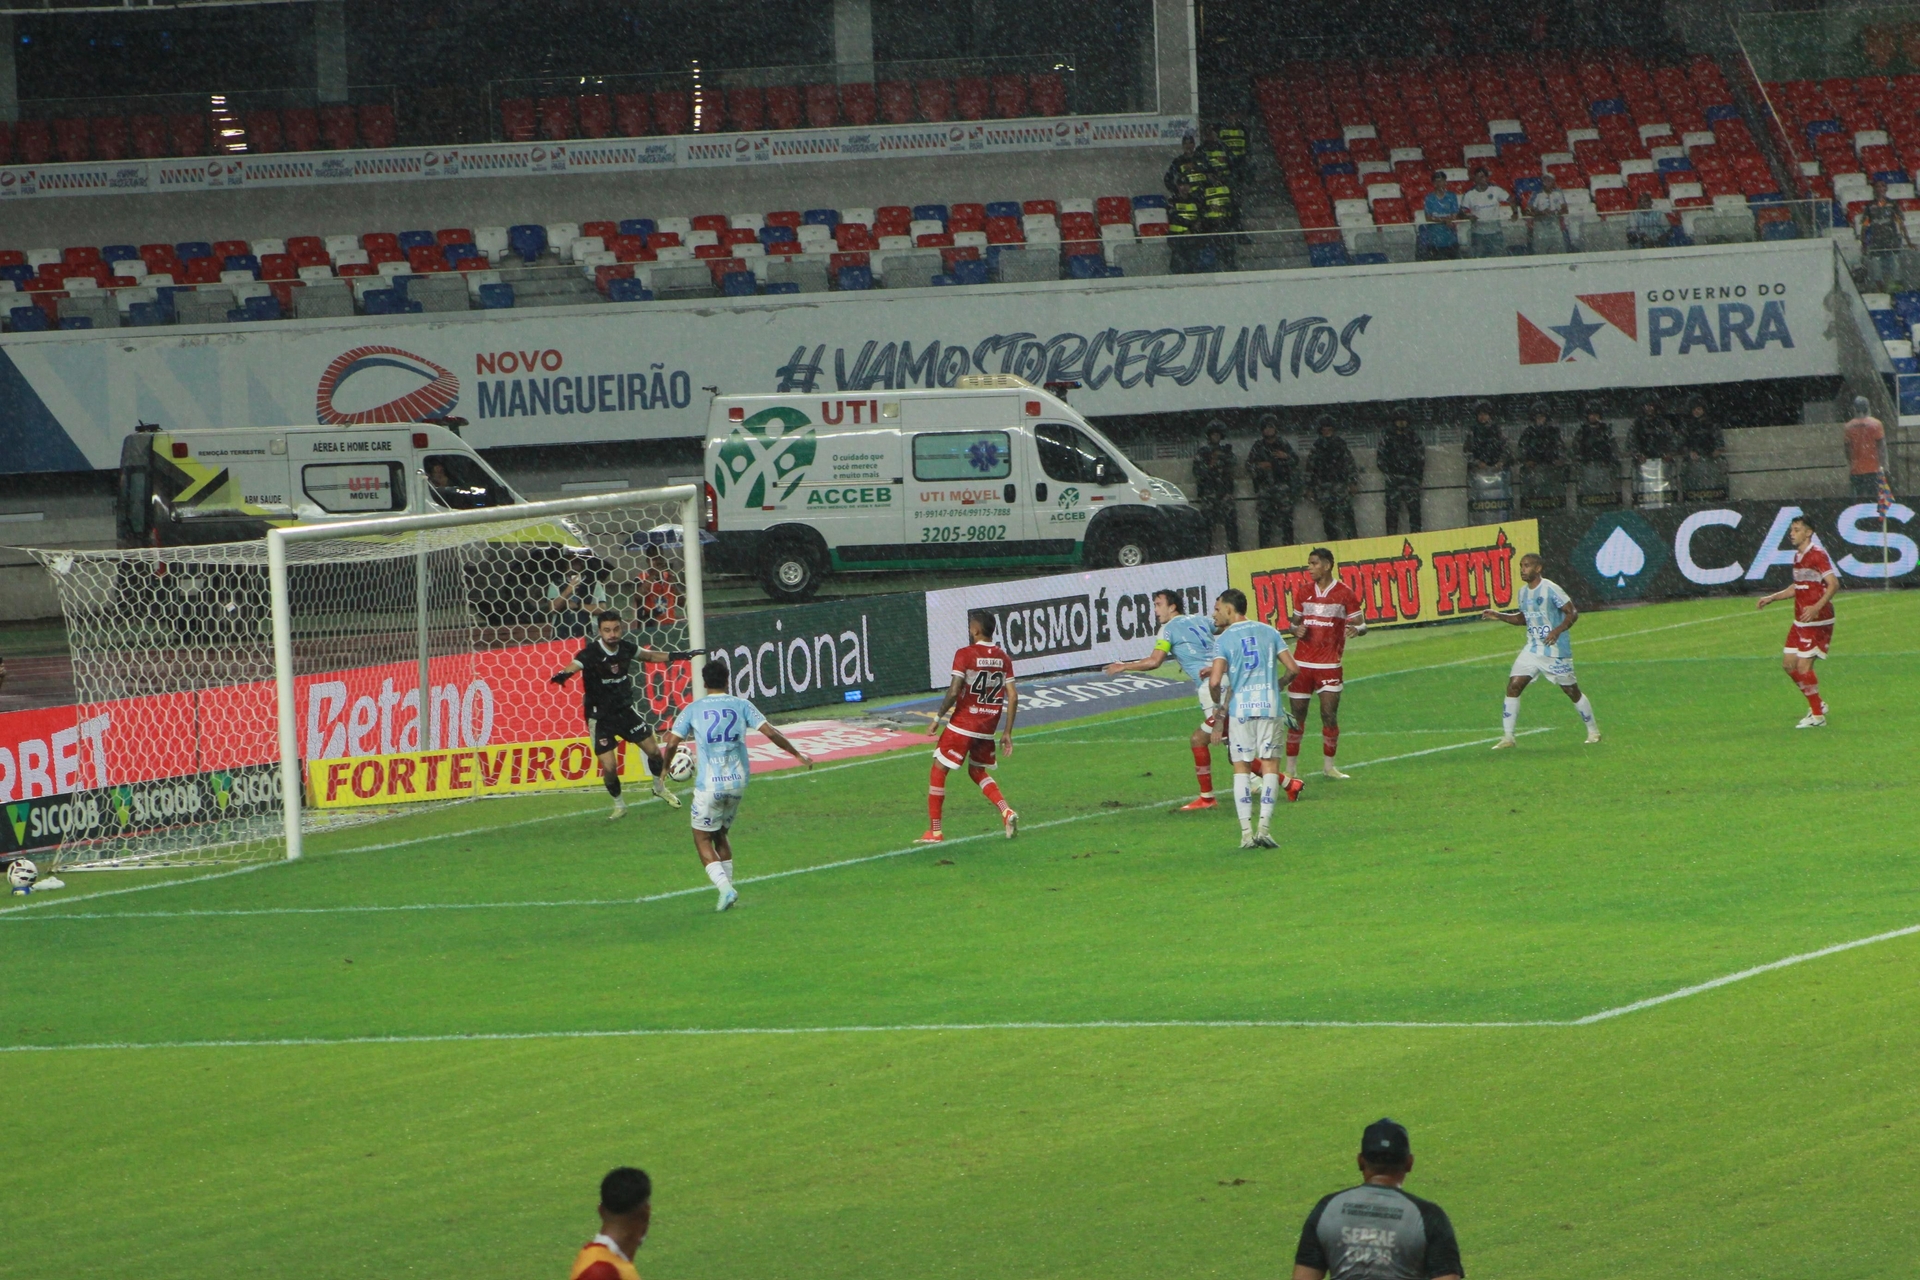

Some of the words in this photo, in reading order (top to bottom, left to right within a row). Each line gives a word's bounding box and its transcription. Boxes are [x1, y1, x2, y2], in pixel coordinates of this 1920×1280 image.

[1647, 285, 1747, 302] GOVERNO
[1758, 283, 1786, 296] DO
[1648, 300, 1796, 356] PARÁ
[476, 349, 563, 375] NOVO
[477, 362, 692, 419] MANGUEIRÃO
[821, 400, 878, 426] UTI
[230, 448, 266, 456] TERRESTRE
[312, 440, 338, 453] AÉREA
[340, 443, 346, 452] E
[347, 442, 370, 452] HOME
[371, 441, 392, 451] CARE
[839, 453, 869, 461] cuidado
[870, 454, 884, 462] que
[833, 462, 849, 471] você
[839, 471, 861, 479] muito
[348, 477, 380, 492] UTI
[350, 491, 379, 500] MÓVEL
[919, 492, 945, 503] UTI
[949, 488, 1001, 501] MÓVEL
[244, 496, 259, 505] ABM
[806, 487, 892, 505] ACCEB
[1050, 511, 1086, 521] ACCEB
[921, 525, 1007, 543] 3205-9802
[1675, 503, 1919, 585] CAS
[1432, 527, 1515, 616] PITÚ
[1251, 565, 1313, 632] PIT
[1094, 587, 1110, 643] É
[1241, 636, 1260, 671] 5
[969, 669, 1004, 705] 42
[1239, 700, 1271, 710] mirella
[307, 676, 494, 776] Betano
[703, 708, 740, 744] 22
[711, 773, 742, 782] mirella
[233, 772, 284, 806] SICOO
[135, 784, 201, 822] SICOOB
[30, 800, 100, 838] SICOOB
